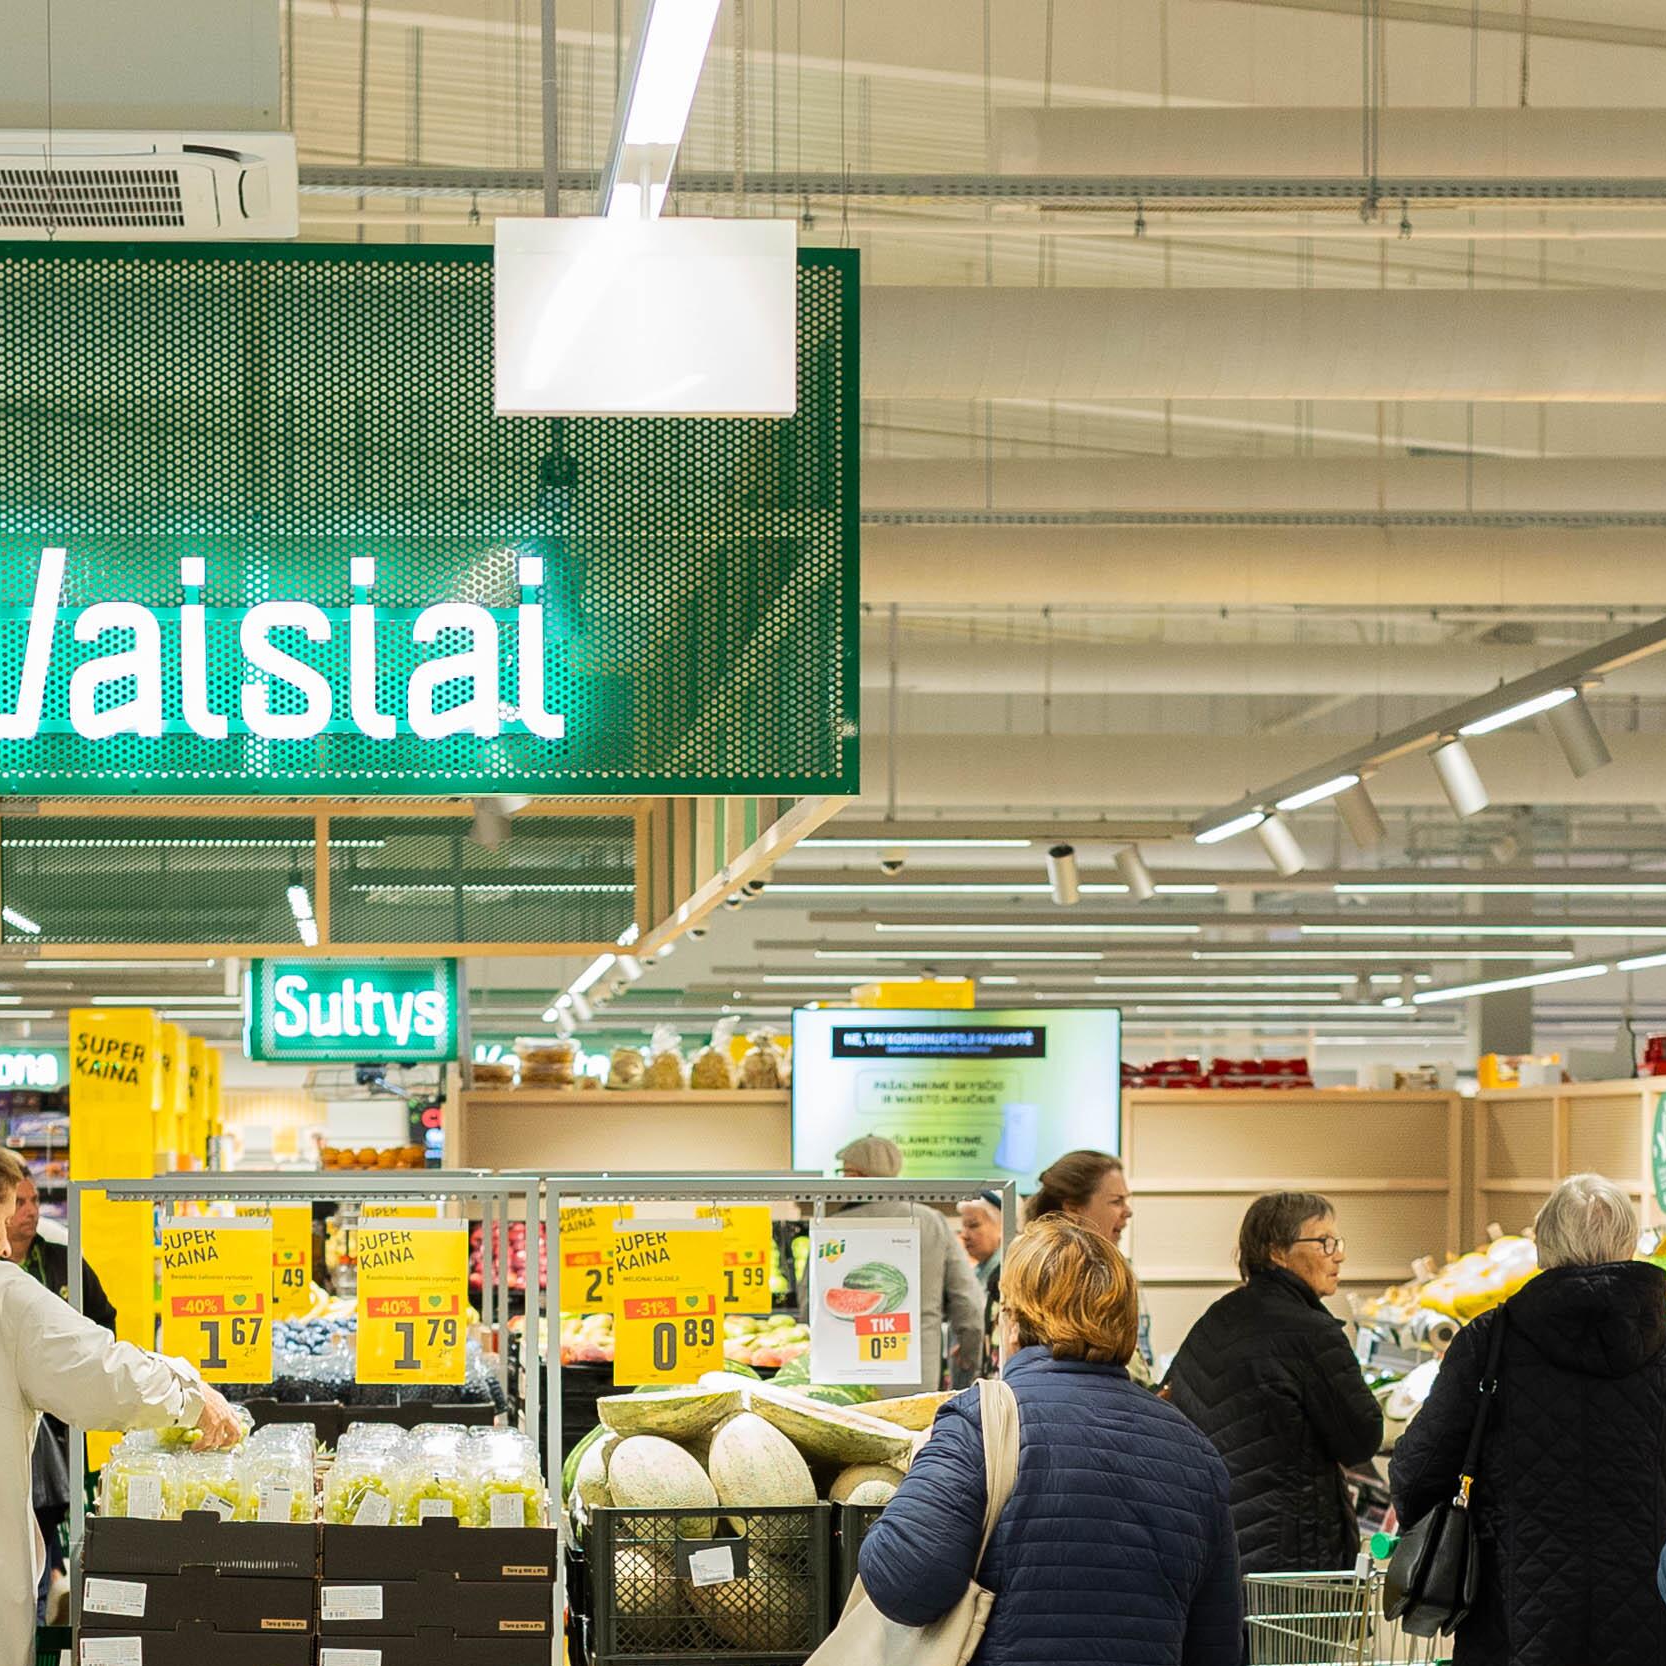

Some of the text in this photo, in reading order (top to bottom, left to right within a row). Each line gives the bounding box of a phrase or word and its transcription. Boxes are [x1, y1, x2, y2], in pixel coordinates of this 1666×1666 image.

[273, 975, 447, 1047] Sultys
[76, 1032, 145, 1063] SUPER
[76, 1055, 140, 1086] KAINA
[164, 1246, 219, 1270] KAINA
[360, 1247, 414, 1271] KAINA
[617, 1248, 671, 1272] KAINA
[818, 1239, 845, 1259] iki
[181, 1299, 218, 1314] -40%
[374, 1299, 413, 1315] -40%
[636, 1301, 670, 1316] -31%
[870, 1317, 896, 1333] TIK
